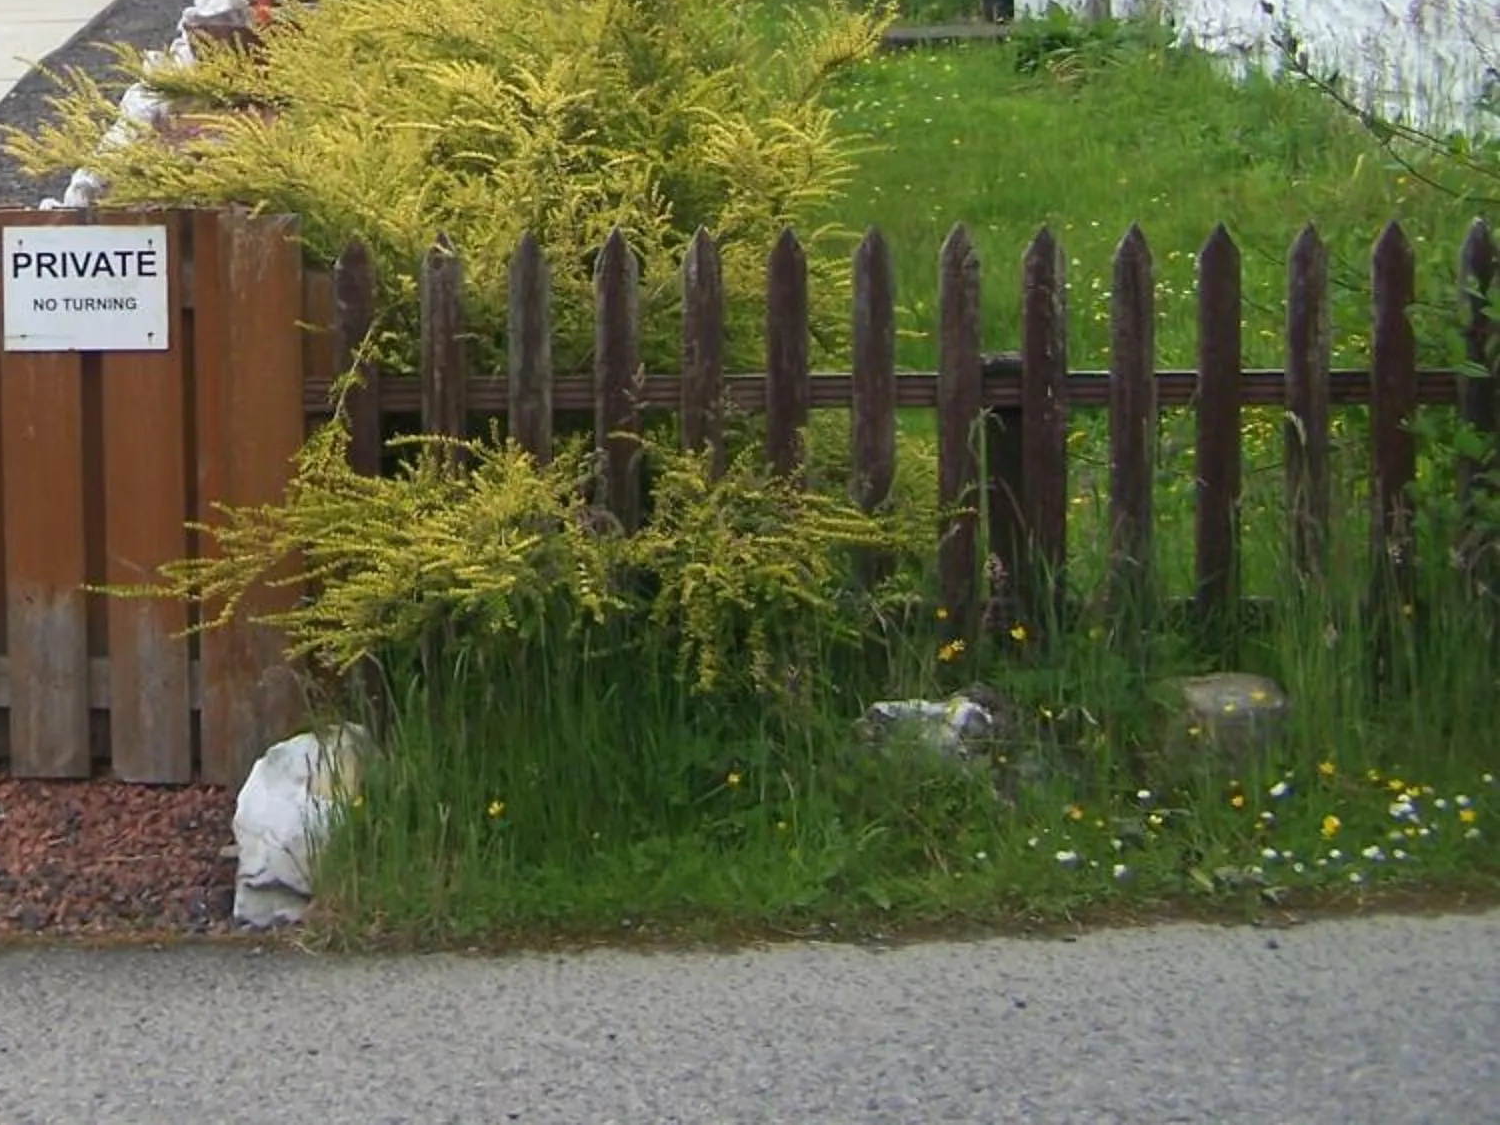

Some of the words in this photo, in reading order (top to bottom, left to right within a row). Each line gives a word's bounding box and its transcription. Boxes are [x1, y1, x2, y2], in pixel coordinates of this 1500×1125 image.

[12, 251, 157, 278] PRIVATE
[33, 298, 58, 311] NO
[63, 297, 137, 311] TURNING
